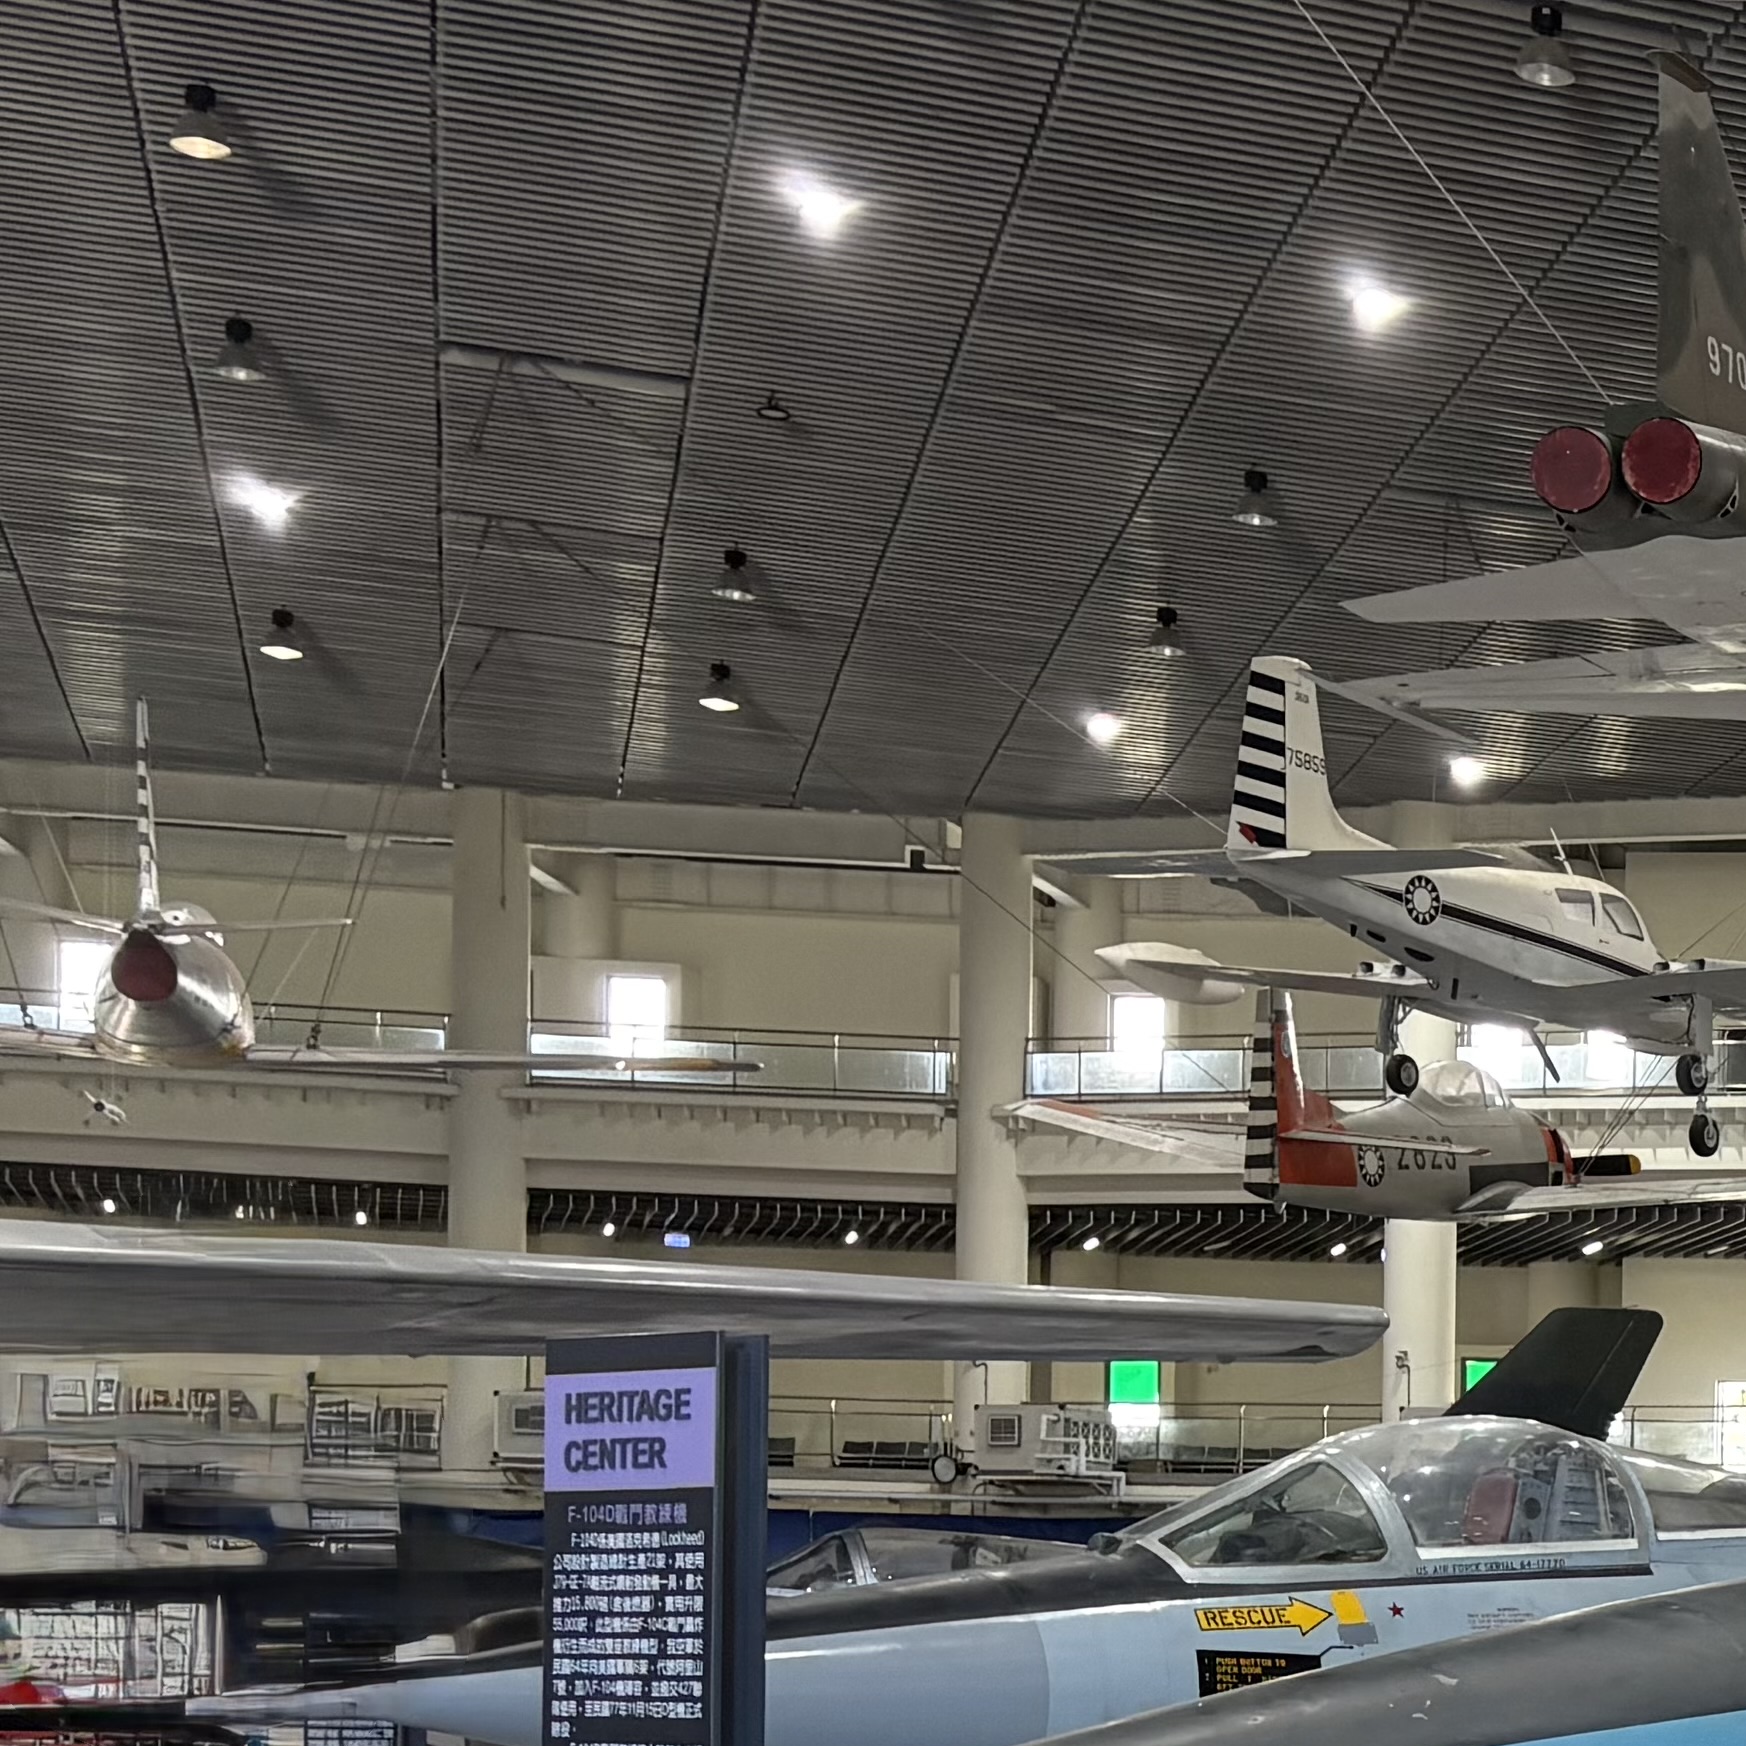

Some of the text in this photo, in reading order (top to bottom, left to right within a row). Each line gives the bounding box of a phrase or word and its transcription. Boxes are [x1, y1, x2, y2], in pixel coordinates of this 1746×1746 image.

[565, 1388, 691, 1424] HERITAGE
[564, 1437, 667, 1472] CENTER
[1416, 1567, 1427, 1576] US
[1433, 1565, 1448, 1575] AIR
[1203, 1608, 1291, 1627] RESCUE
